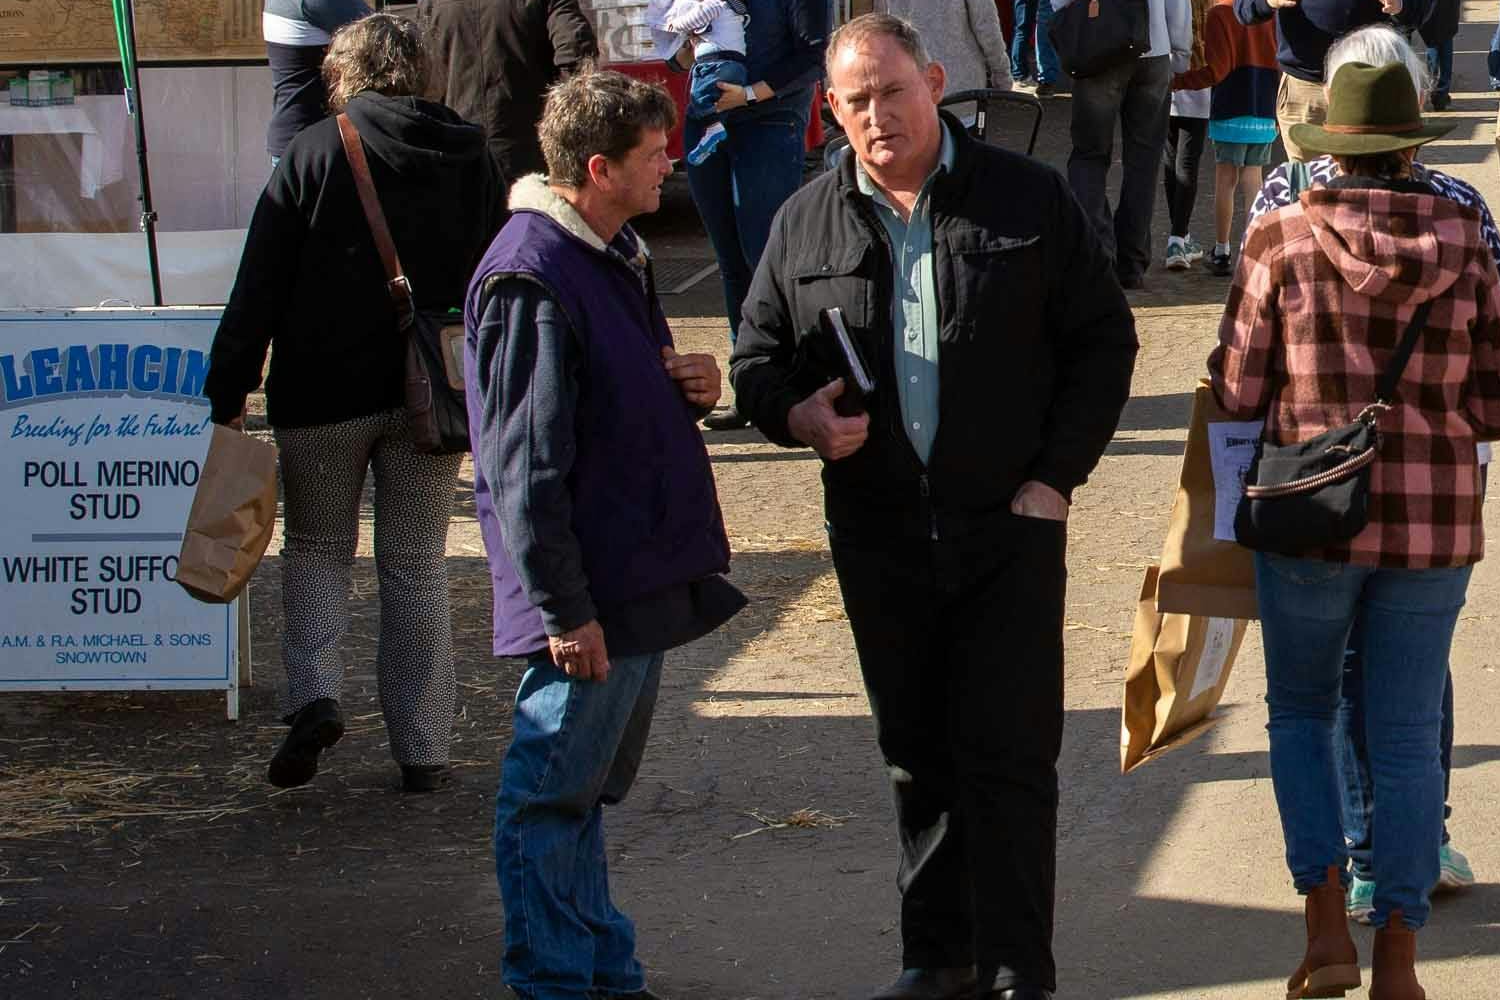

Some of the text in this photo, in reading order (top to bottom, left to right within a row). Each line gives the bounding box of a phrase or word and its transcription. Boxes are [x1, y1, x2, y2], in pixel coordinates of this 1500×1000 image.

[11, 414, 210, 446] Breeding for the Future!
[23, 460, 200, 488] POLL MERINO
[69, 493, 141, 520] STUD
[3, 555, 181, 583] WHITE SUFFO
[70, 587, 142, 615] STUD
[1, 635, 31, 648] A.M.
[36, 635, 46, 648] &
[83, 634, 148, 647] MICHAEL
[154, 634, 164, 647] &
[169, 633, 212, 647] SONS
[55, 651, 147, 664] SNOWTOWN
